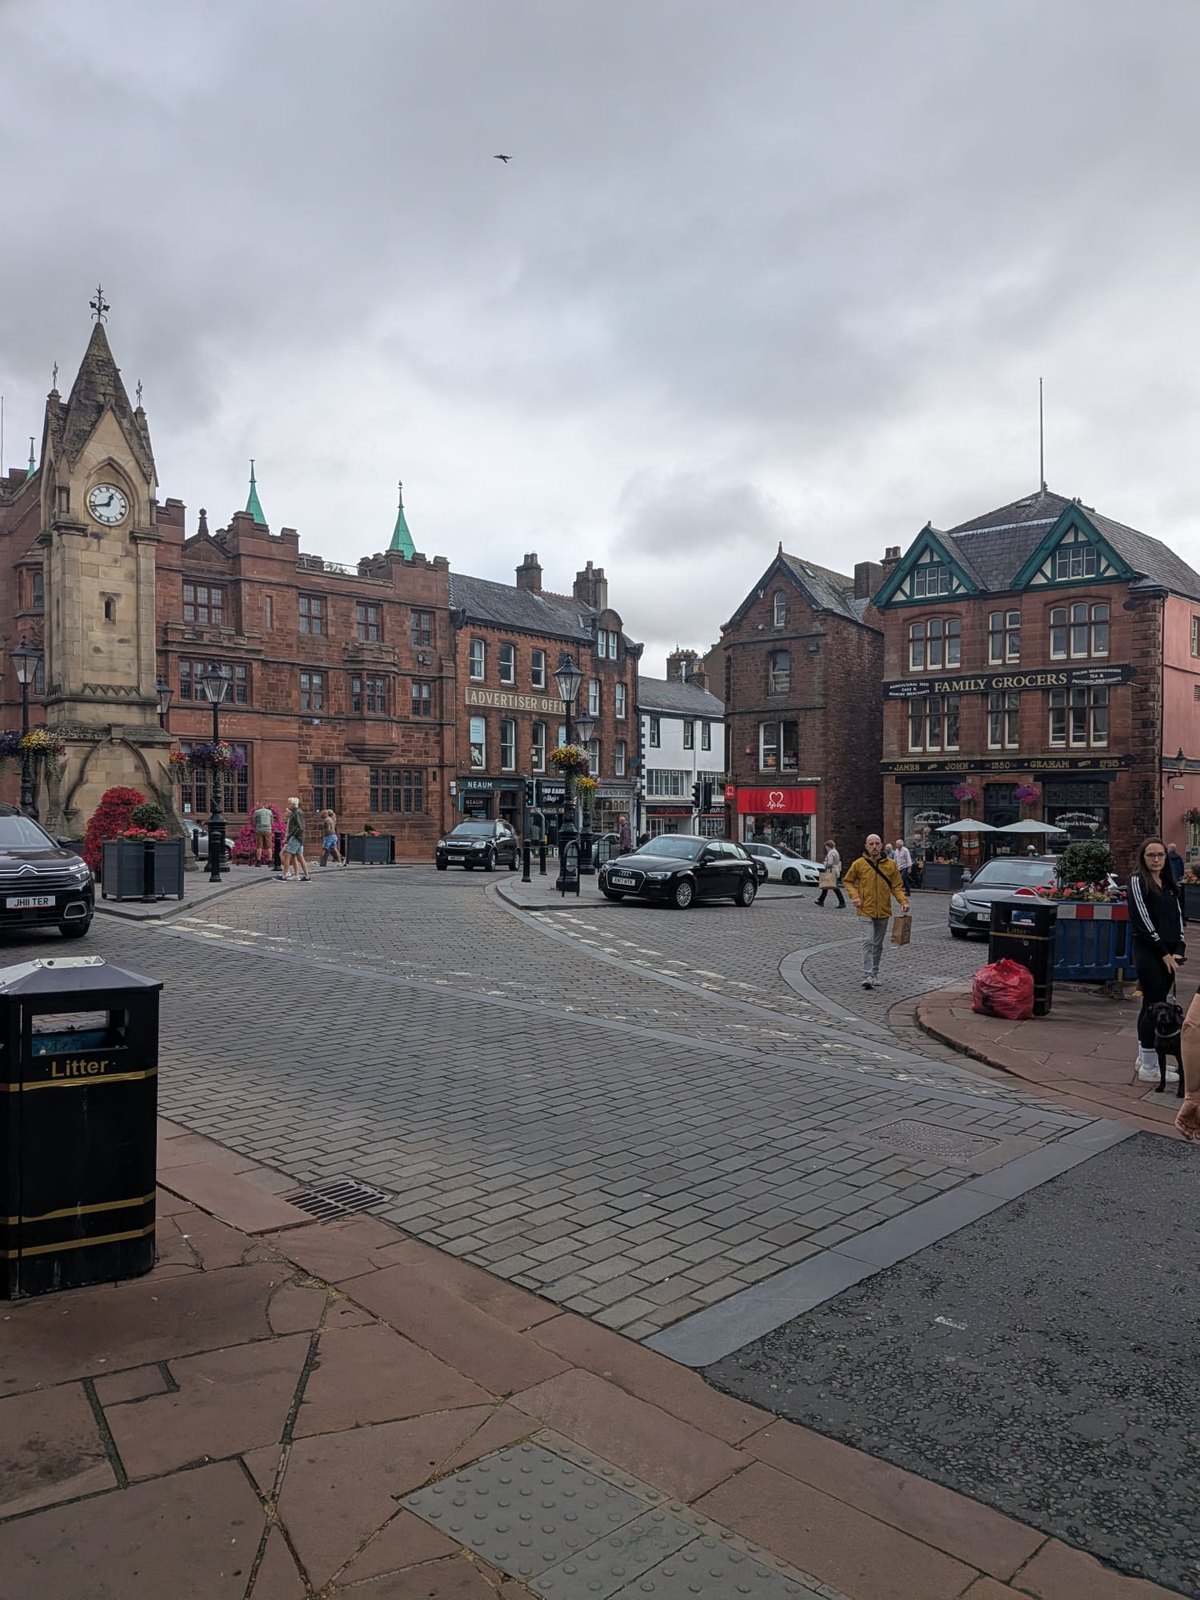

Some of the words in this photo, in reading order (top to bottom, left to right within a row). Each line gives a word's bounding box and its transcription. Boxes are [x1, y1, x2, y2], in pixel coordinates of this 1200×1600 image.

[934, 679, 988, 693] FAMILY
[992, 672, 1068, 689] GROCERS
[470, 690, 538, 710] ADVERTISER
[541, 699, 567, 712] OFFIC
[894, 764, 920, 772] JAMES
[944, 762, 969, 770] JOHN
[1029, 760, 1070, 768] GRAHAM
[467, 781, 493, 789] NEAUM
[14, 898, 30, 907] JH11
[31, 897, 49, 906] TER
[1007, 927, 1028, 935] Litter
[52, 1059, 109, 1077] Litter
